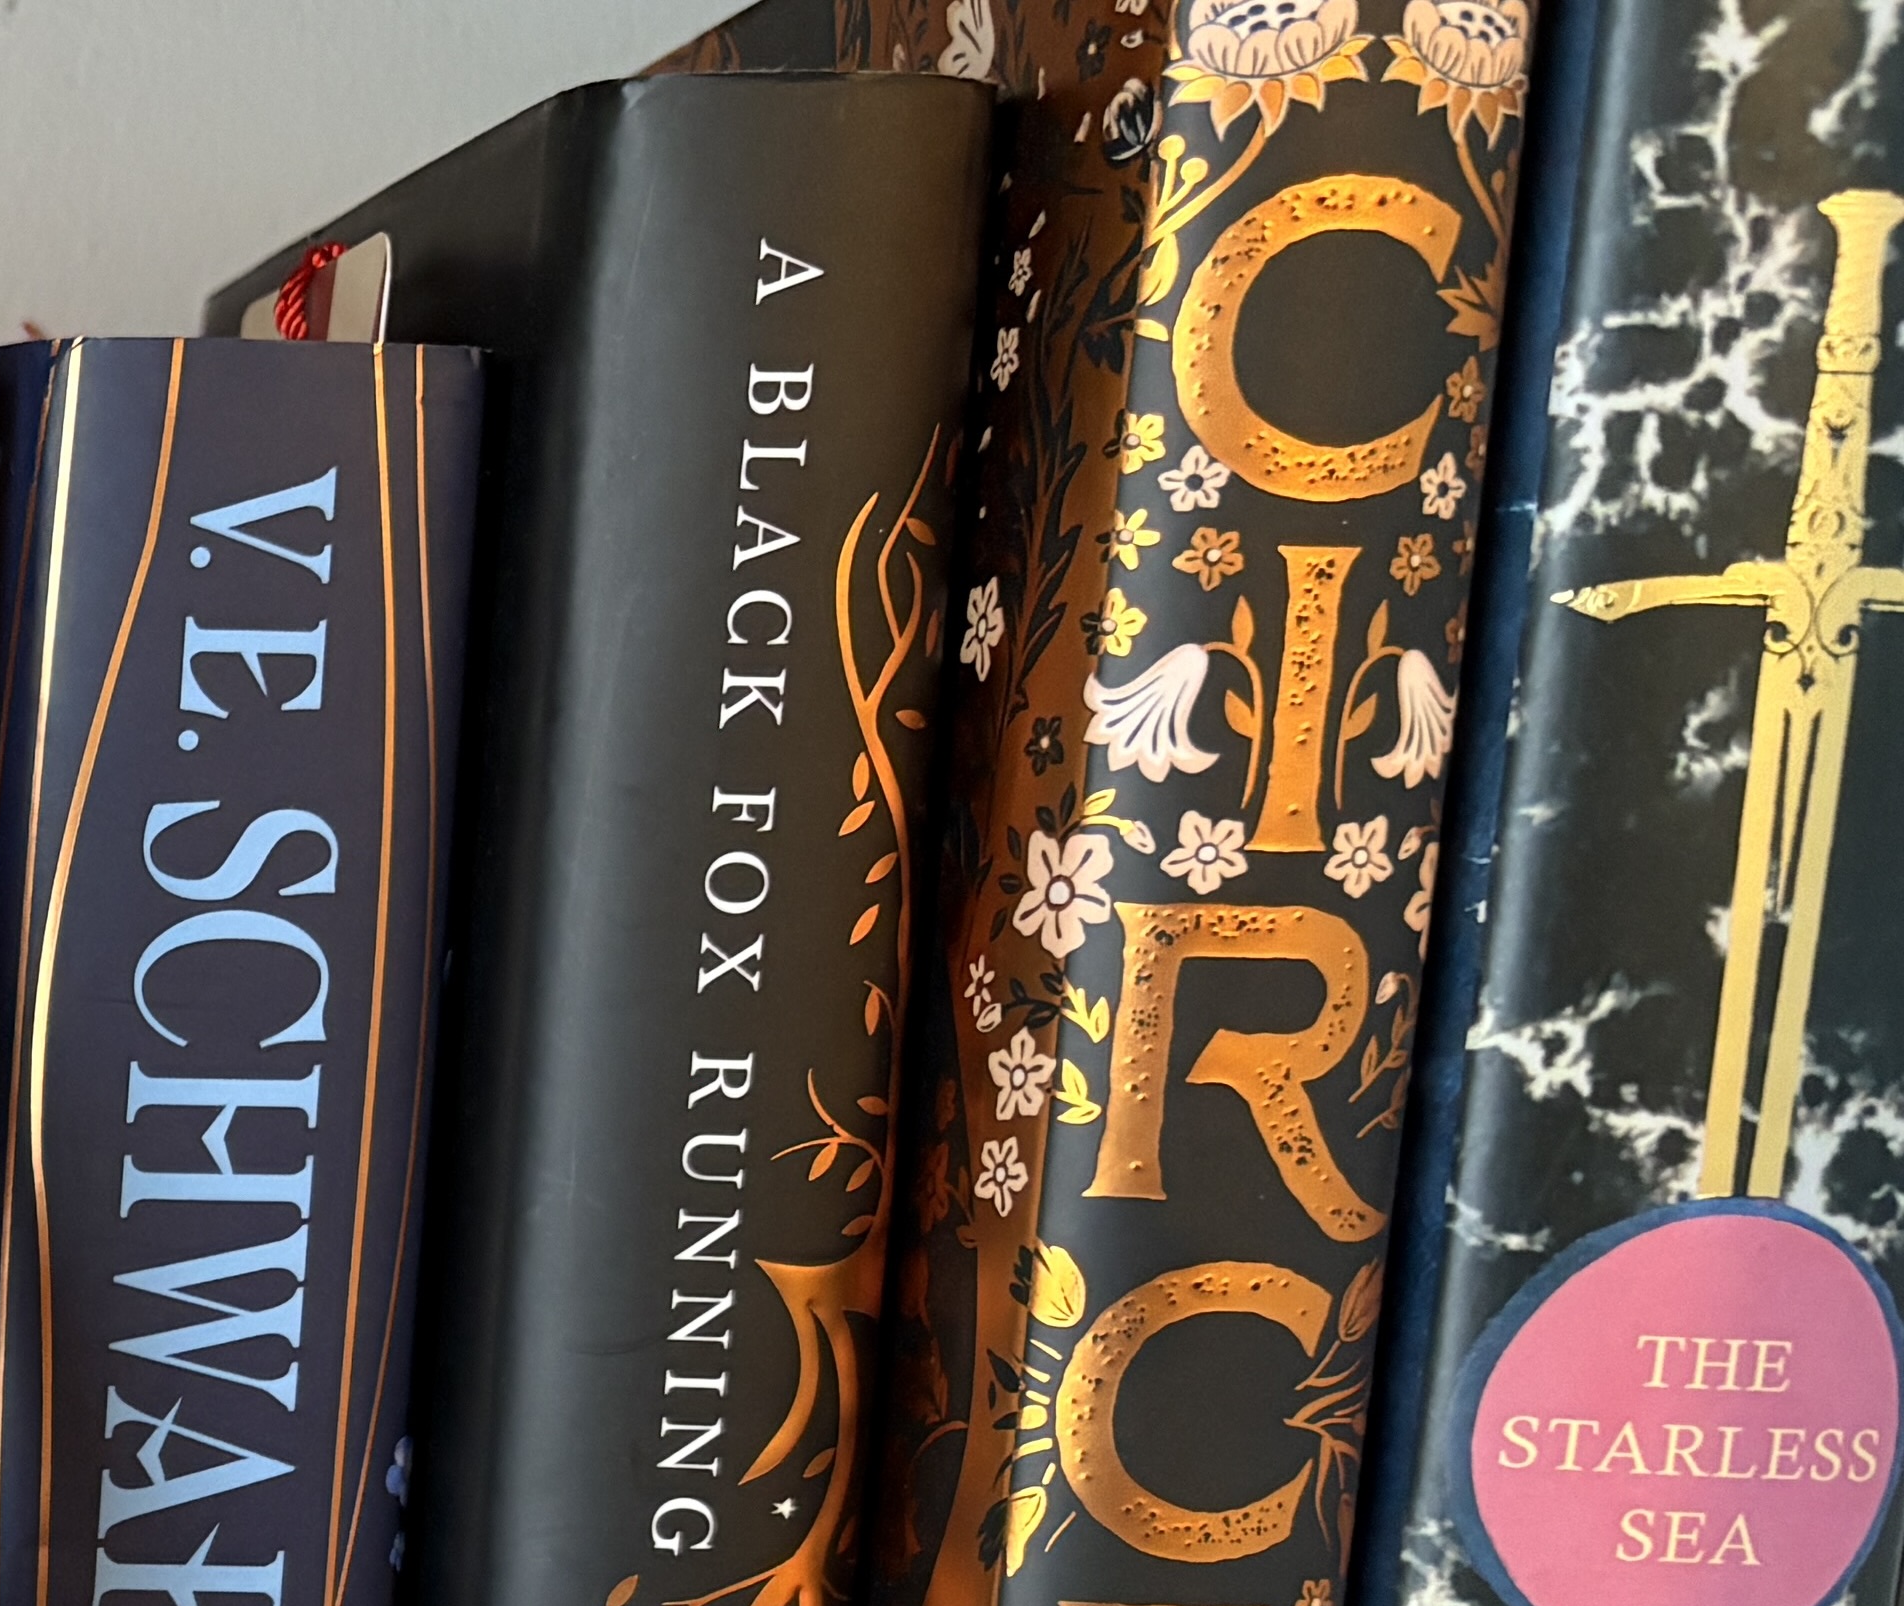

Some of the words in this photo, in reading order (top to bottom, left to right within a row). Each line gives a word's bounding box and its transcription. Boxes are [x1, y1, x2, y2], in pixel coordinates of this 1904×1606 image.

[756, 237, 825, 305] A
[718, 362, 814, 730] BLACK
[696, 786, 777, 994] FOX
[650, 1051, 754, 1557] RUNNING
[1636, 1335, 1792, 1393] THE
[1497, 1415, 1880, 1483] STARLESS
[1615, 1509, 1761, 1566] SEA
